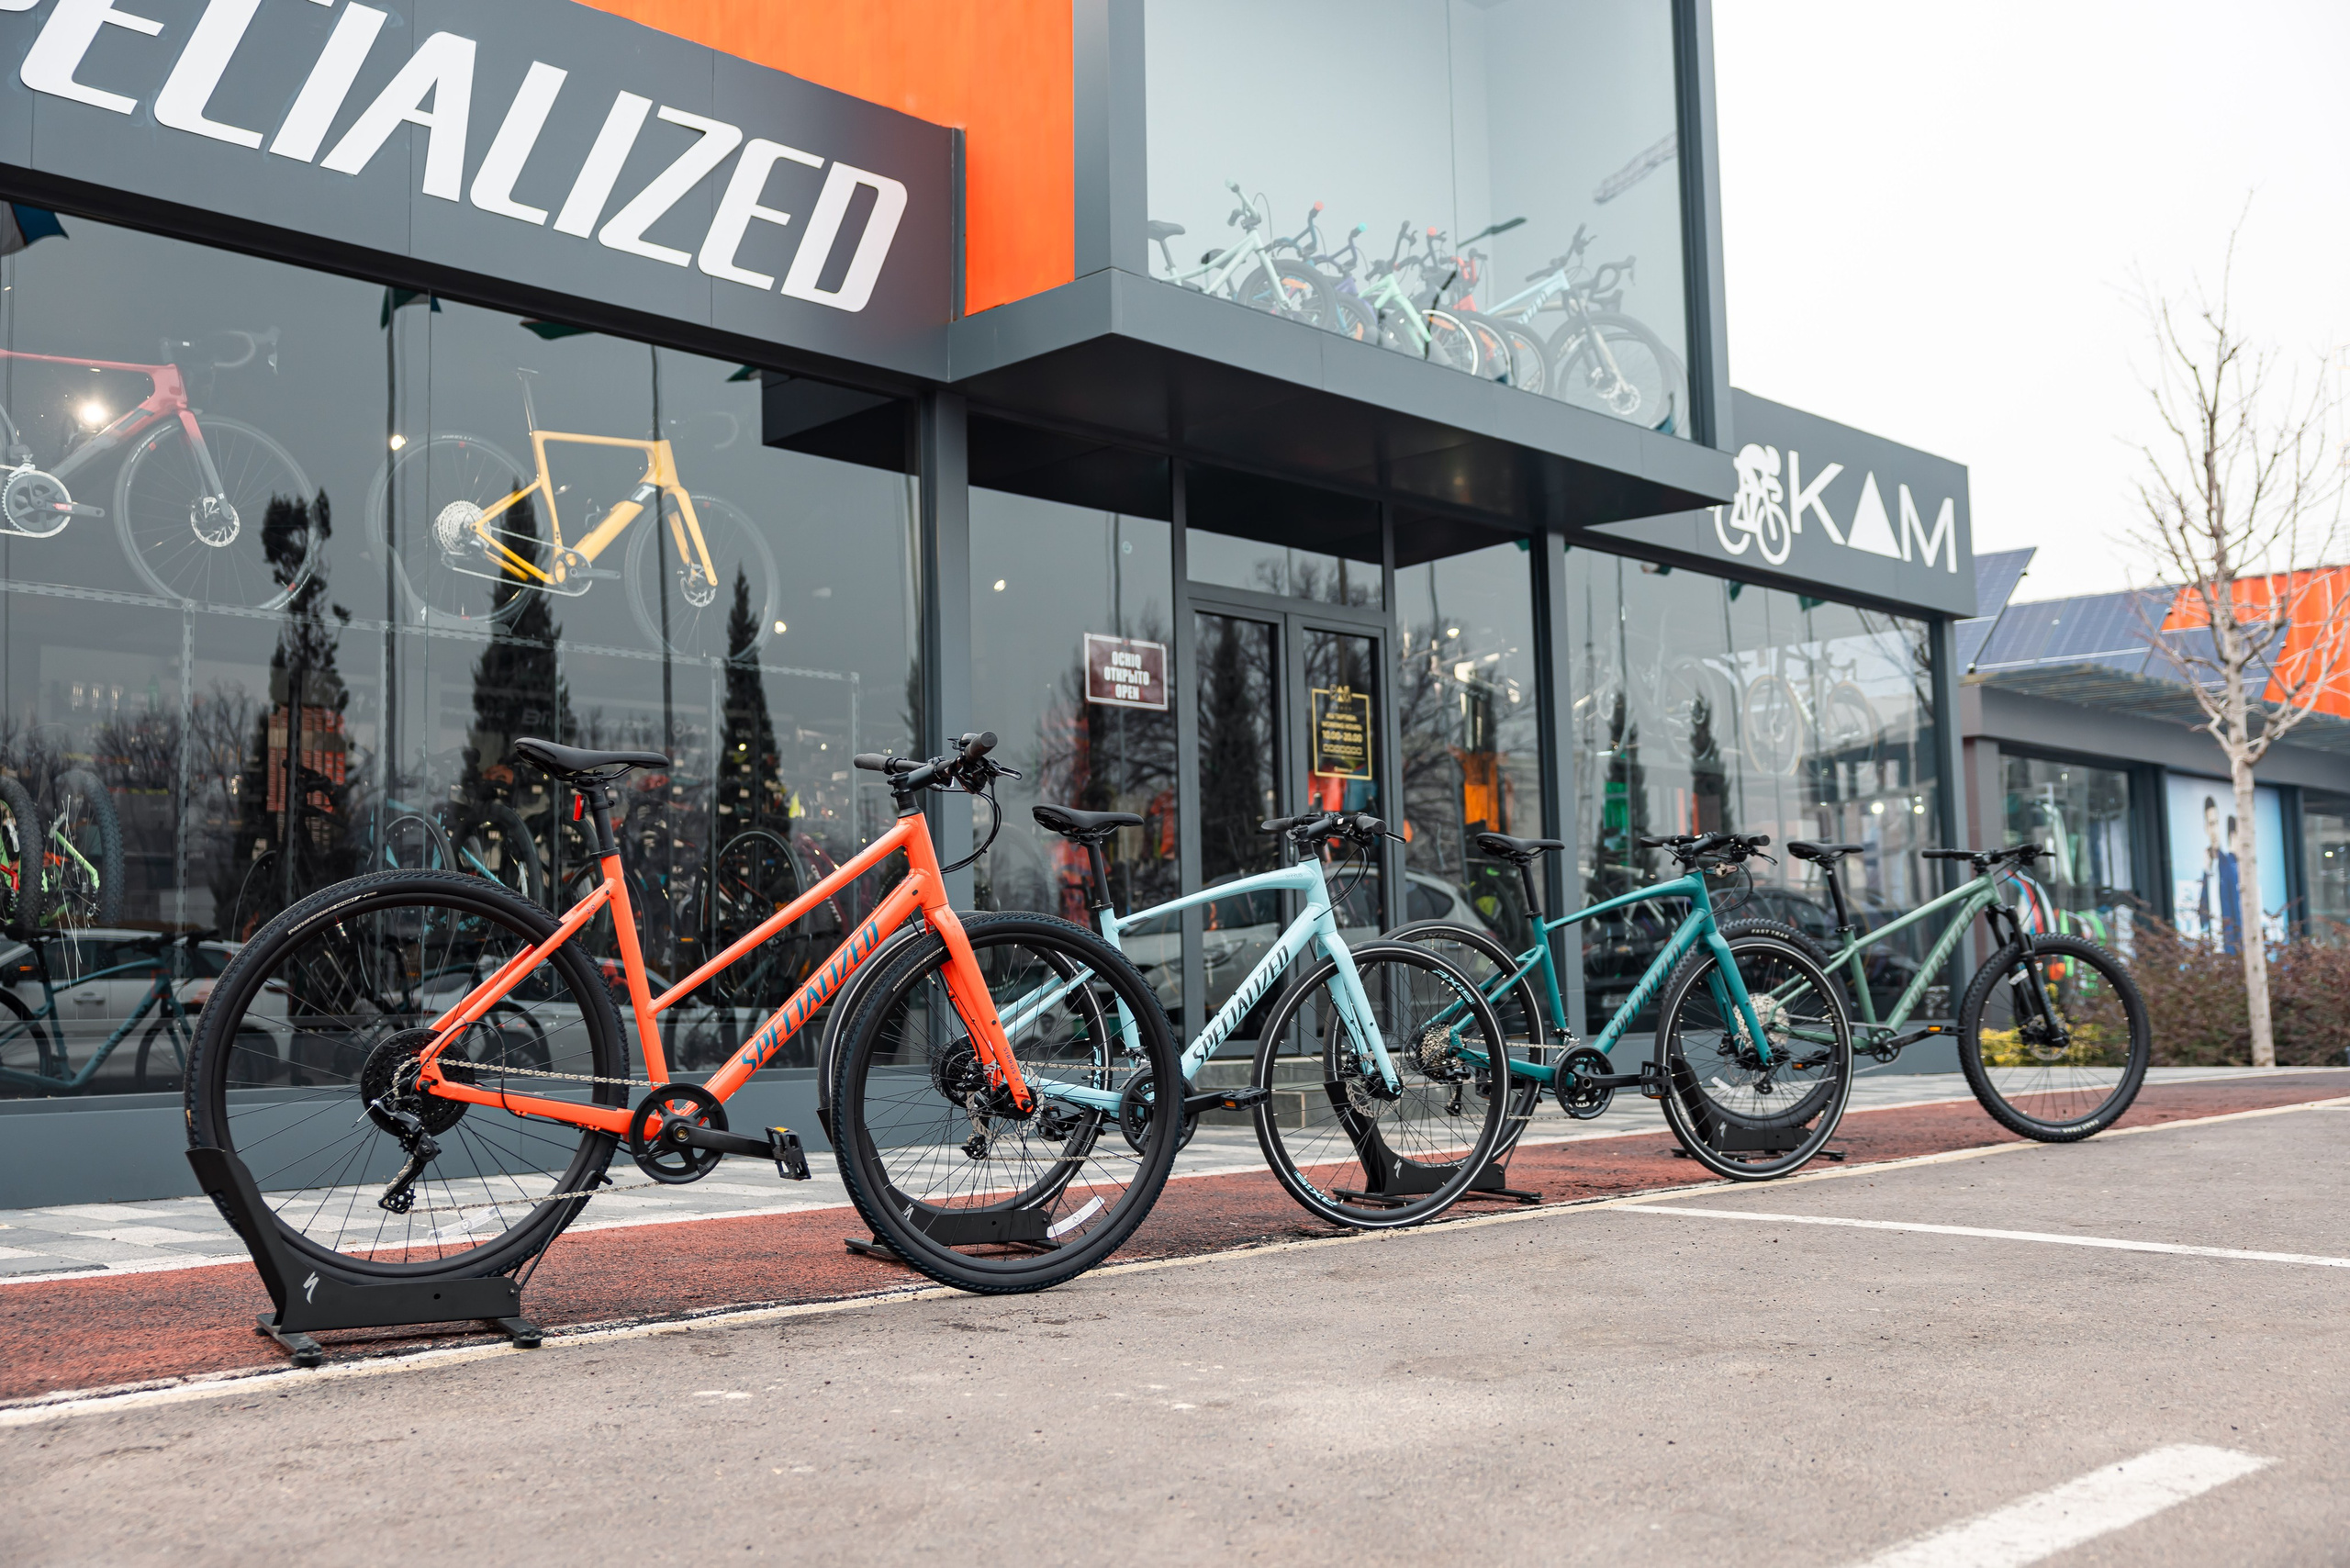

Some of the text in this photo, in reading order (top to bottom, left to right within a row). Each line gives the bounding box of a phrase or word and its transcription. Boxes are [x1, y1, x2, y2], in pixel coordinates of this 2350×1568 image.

[0, 0, 907, 313] ECIALIZED
[1103, 666, 1150, 687] ОТКРЫТО
[1111, 650, 1141, 670] OCHIQ
[1114, 683, 1140, 700] OPEN
[742, 921, 878, 1080] SPECIALIZED
[1192, 945, 1289, 1071] SPECIALIZED
[1606, 943, 1682, 1045] SPECIALIZED
[1003, 1047, 1017, 1074] SIRRUS
